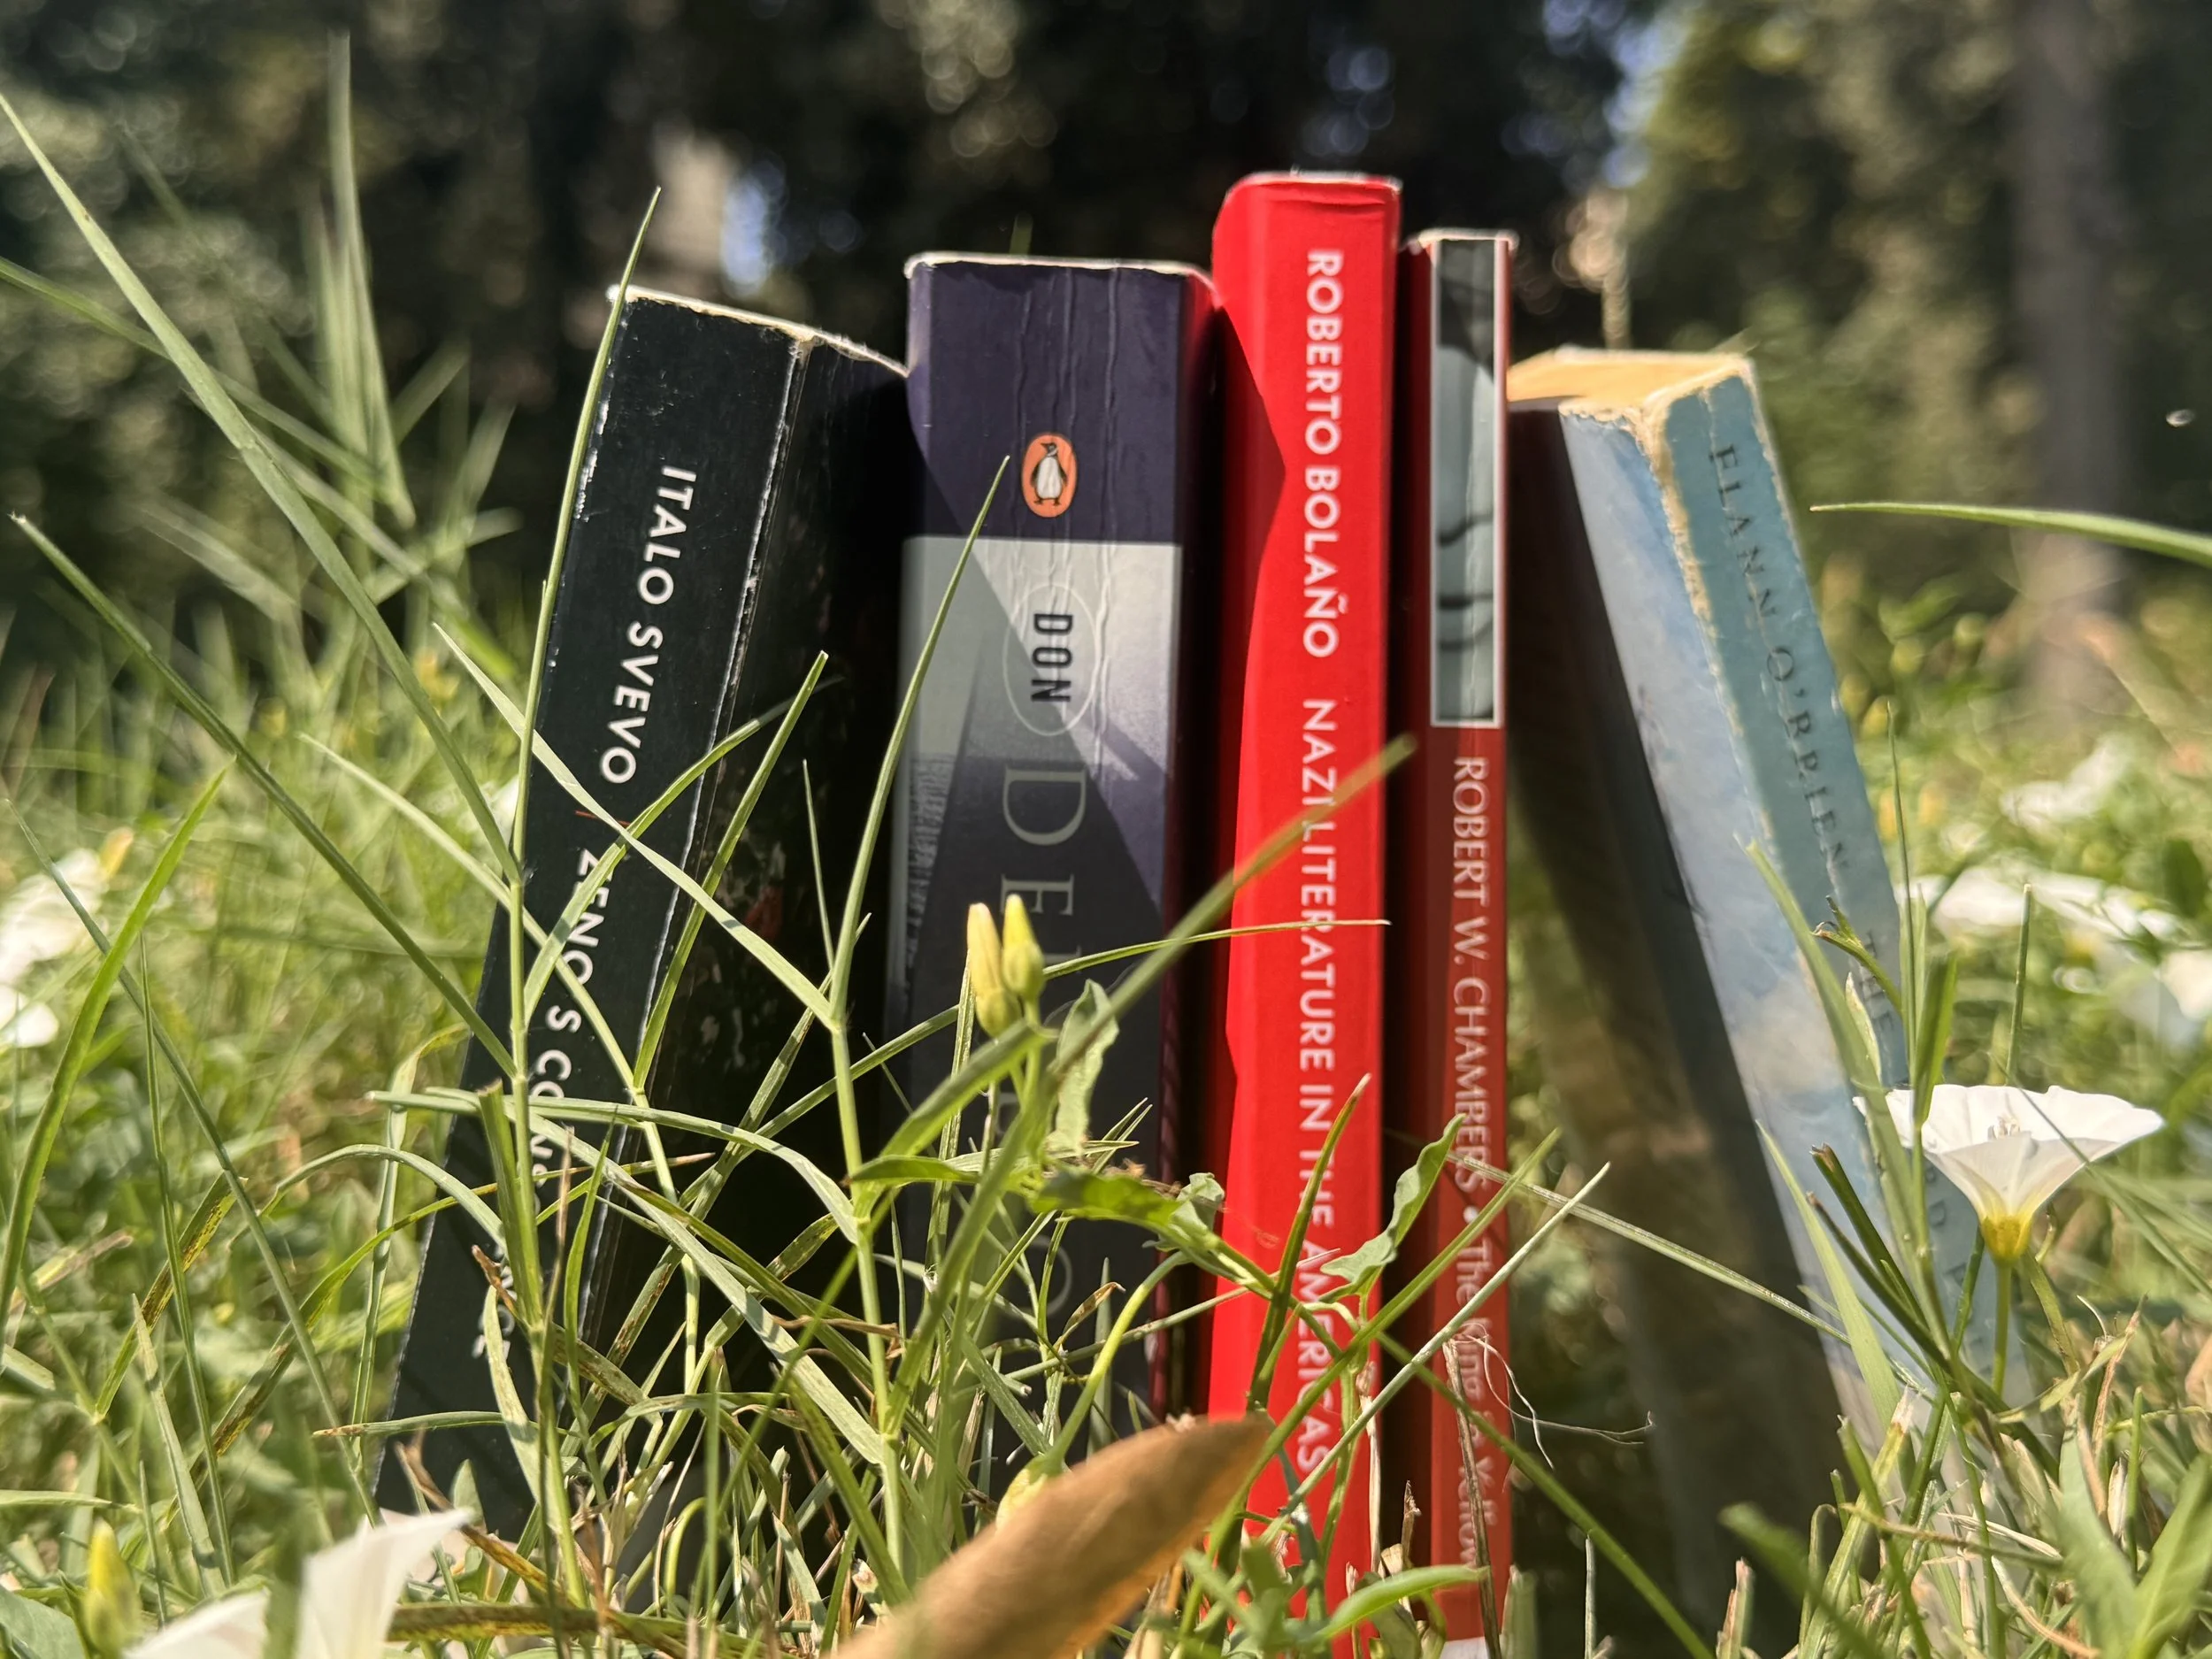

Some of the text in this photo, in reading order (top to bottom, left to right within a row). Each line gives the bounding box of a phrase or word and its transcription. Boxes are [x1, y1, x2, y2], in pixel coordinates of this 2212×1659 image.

[1304, 248, 1343, 456] ROBERTO
[637, 465, 697, 605] ITALO
[1302, 466, 1348, 658] BOLAÑO
[1709, 444, 1778, 618] FLANN
[600, 620, 664, 784] SVEVO
[1030, 612, 1074, 703] DON
[1301, 697, 1338, 806] NAZI
[1452, 756, 1491, 909] ROBERT
[1299, 819, 1338, 1072] LITERATURE
[1453, 915, 1491, 965] W.
[1299, 1084, 1334, 1132] IN
[1454, 975, 1493, 1194] CHAMBERS
[1455, 1236, 1493, 1305] The
